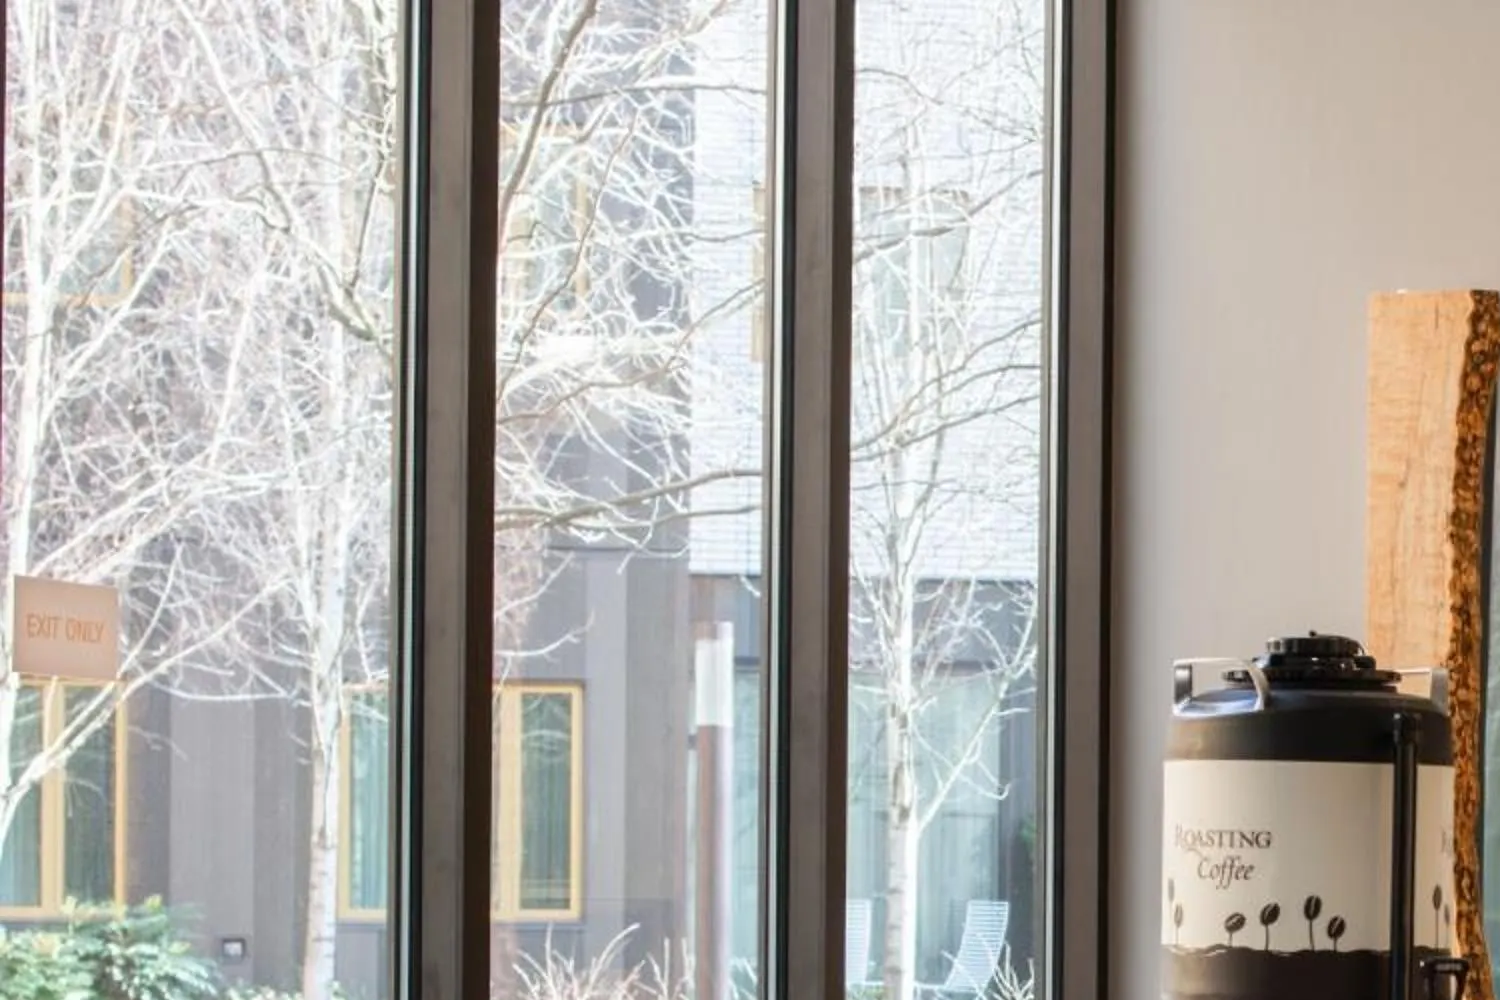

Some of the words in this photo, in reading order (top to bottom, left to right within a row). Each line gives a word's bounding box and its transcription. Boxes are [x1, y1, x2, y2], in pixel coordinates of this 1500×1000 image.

[26, 612, 61, 640] EXIT
[65, 617, 105, 643] ONLY
[1174, 824, 1273, 852] ROASTING
[1197, 854, 1256, 890] Coffee
